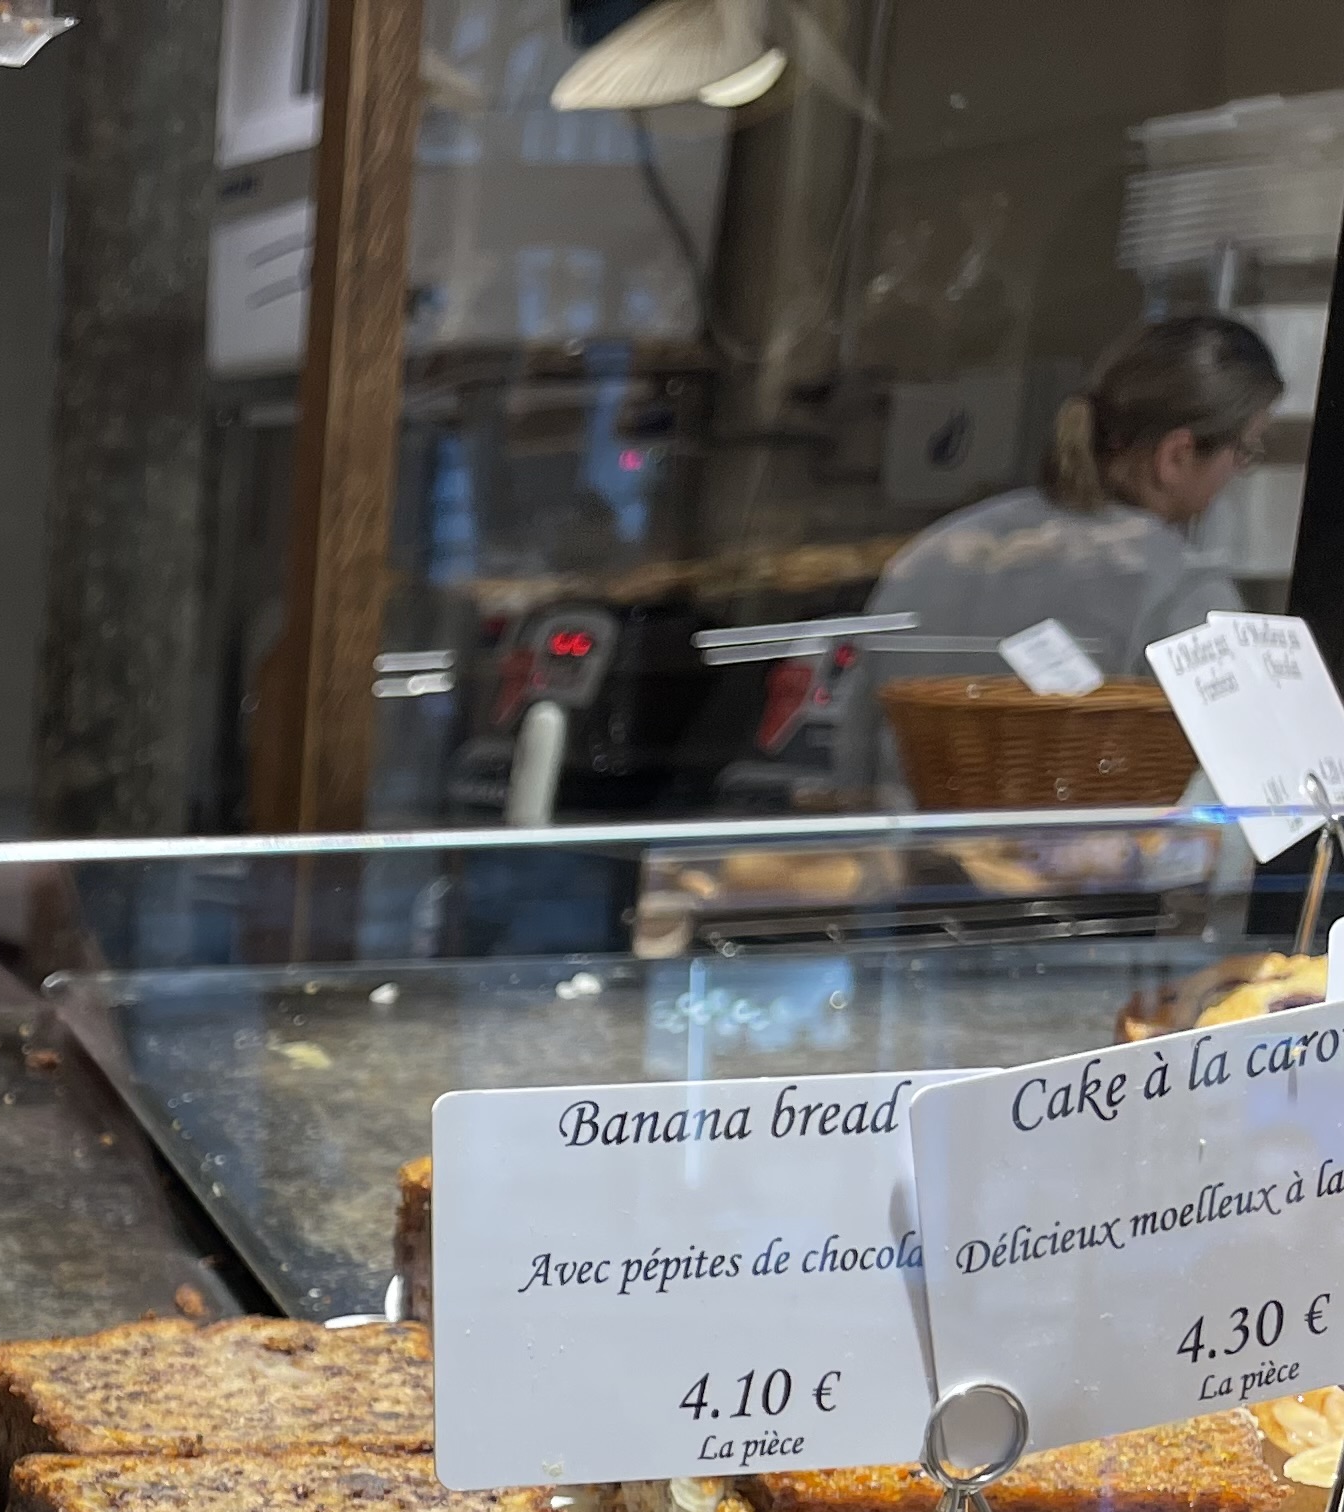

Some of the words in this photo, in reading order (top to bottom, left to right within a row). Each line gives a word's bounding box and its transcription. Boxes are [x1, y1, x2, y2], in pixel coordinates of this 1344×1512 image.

[558, 1100, 752, 1147] Banana
[770, 1079, 913, 1139] bread
[1012, 1058, 1127, 1132] Cake
[1143, 1051, 1172, 1100] à
[1188, 1035, 1231, 1092] la
[1246, 1028, 1344, 1079] caro
[955, 1217, 1126, 1275] Délicieux
[1129, 1182, 1282, 1238] moelleux
[1285, 1170, 1305, 1205] à
[1316, 1158, 1344, 1198] la
[517, 1252, 611, 1293] Avec
[617, 1245, 743, 1296] pépites
[751, 1237, 791, 1276] de
[801, 1229, 925, 1275] chocola
[1176, 1300, 1284, 1363] 4.30
[1304, 1293, 1331, 1335] €
[679, 1368, 792, 1420] 4.10
[812, 1370, 842, 1412] €
[1198, 1374, 1234, 1401] La
[1240, 1360, 1300, 1401] pièce
[697, 1435, 734, 1460] La
[739, 1430, 805, 1467] pièce
